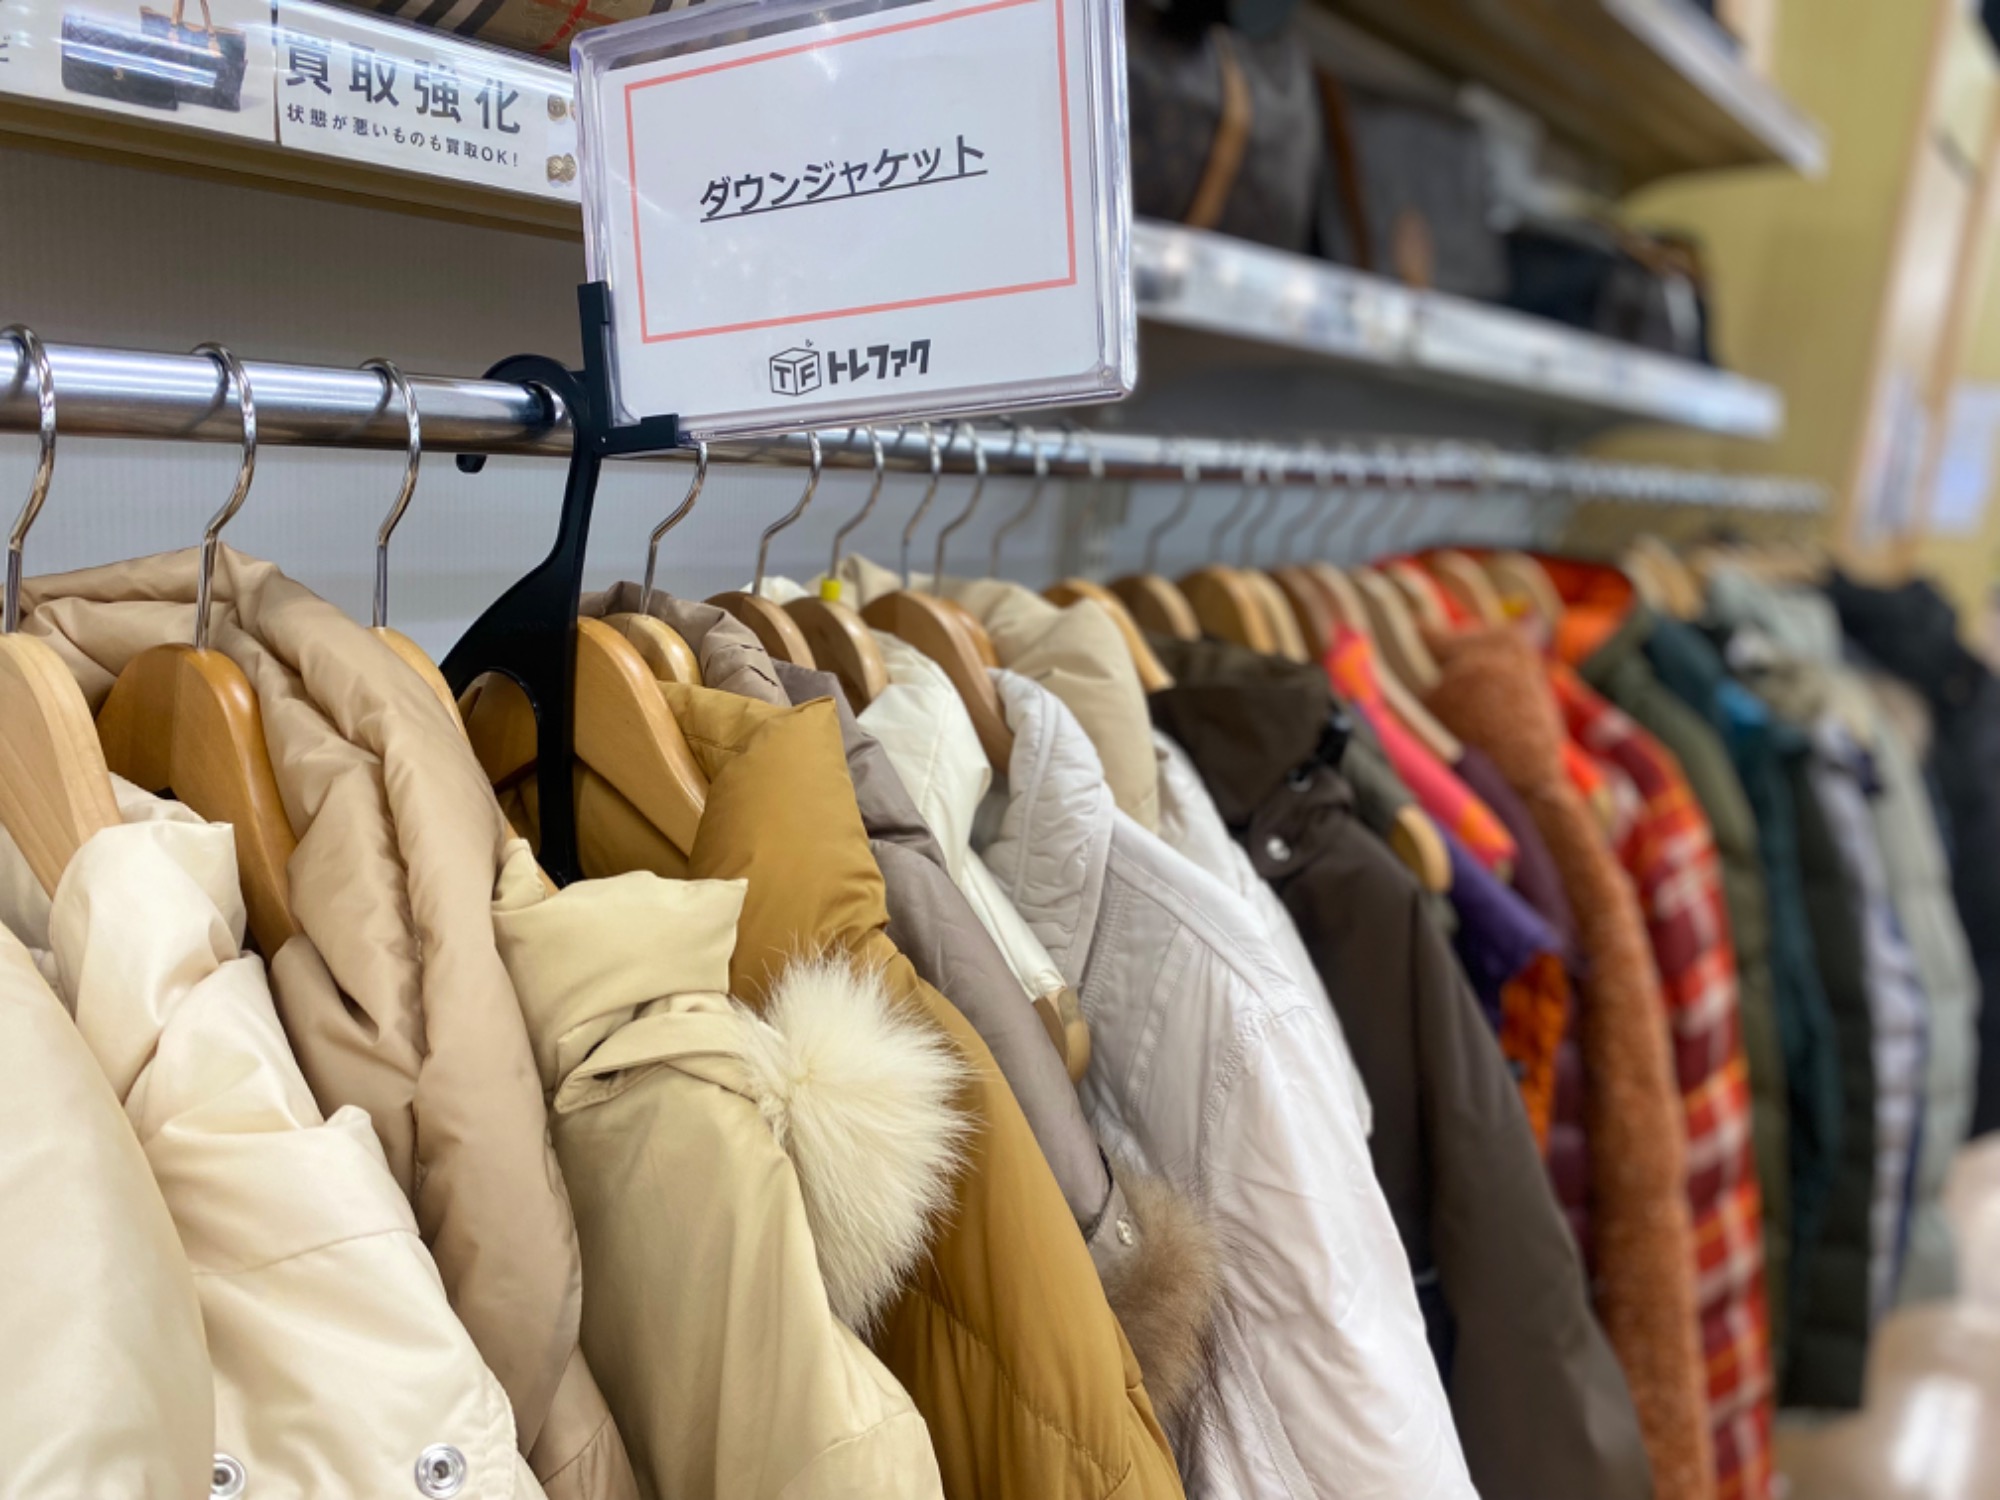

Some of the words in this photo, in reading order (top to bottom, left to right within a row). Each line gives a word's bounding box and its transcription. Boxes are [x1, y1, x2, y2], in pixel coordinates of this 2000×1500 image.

[284, 32, 521, 134] 買取強化
[700, 135, 986, 219] ダウンジャケット
[827, 338, 931, 385] トレファク
